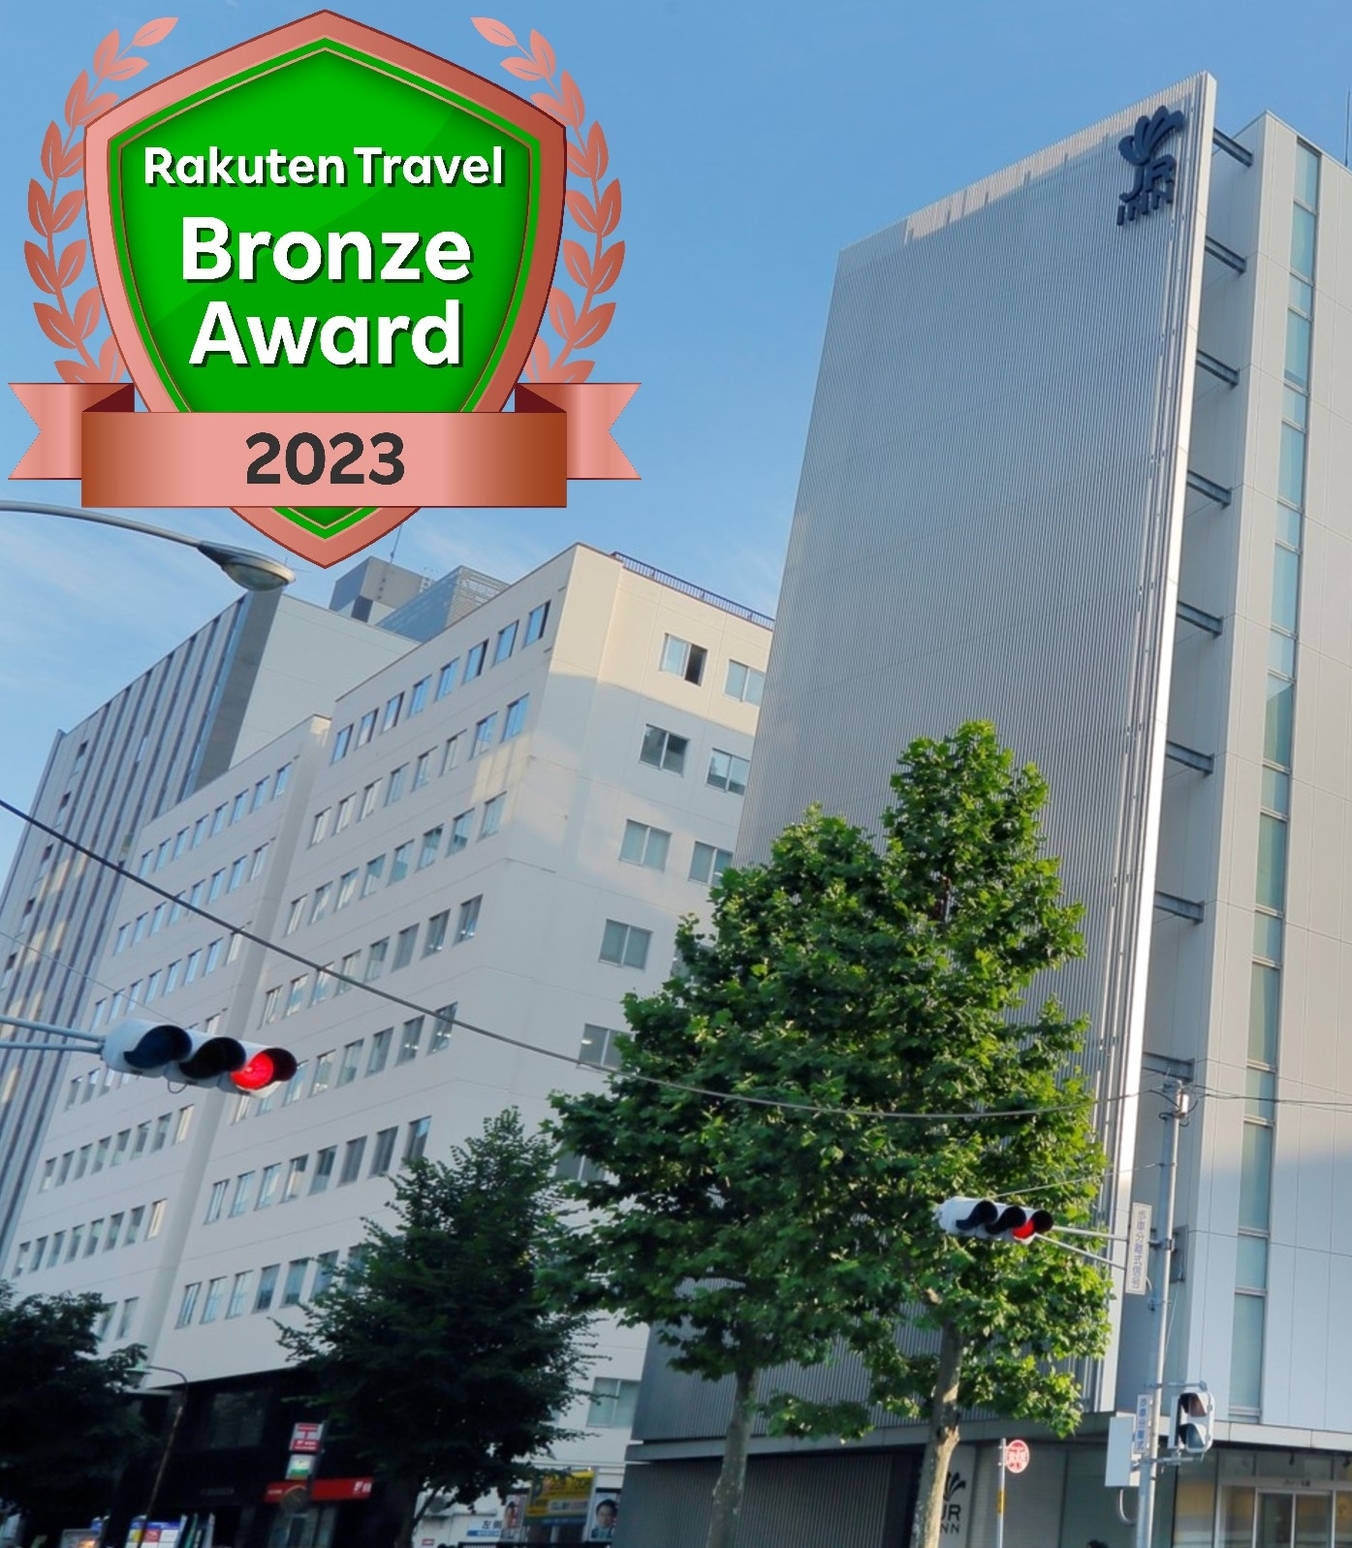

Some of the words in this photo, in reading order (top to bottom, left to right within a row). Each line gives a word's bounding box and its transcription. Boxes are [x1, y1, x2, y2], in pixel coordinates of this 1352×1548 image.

[1119, 154, 1177, 202] JR
[1132, 1209, 1146, 1289] 歩車分離式信号
[941, 1523, 960, 1534] NN
